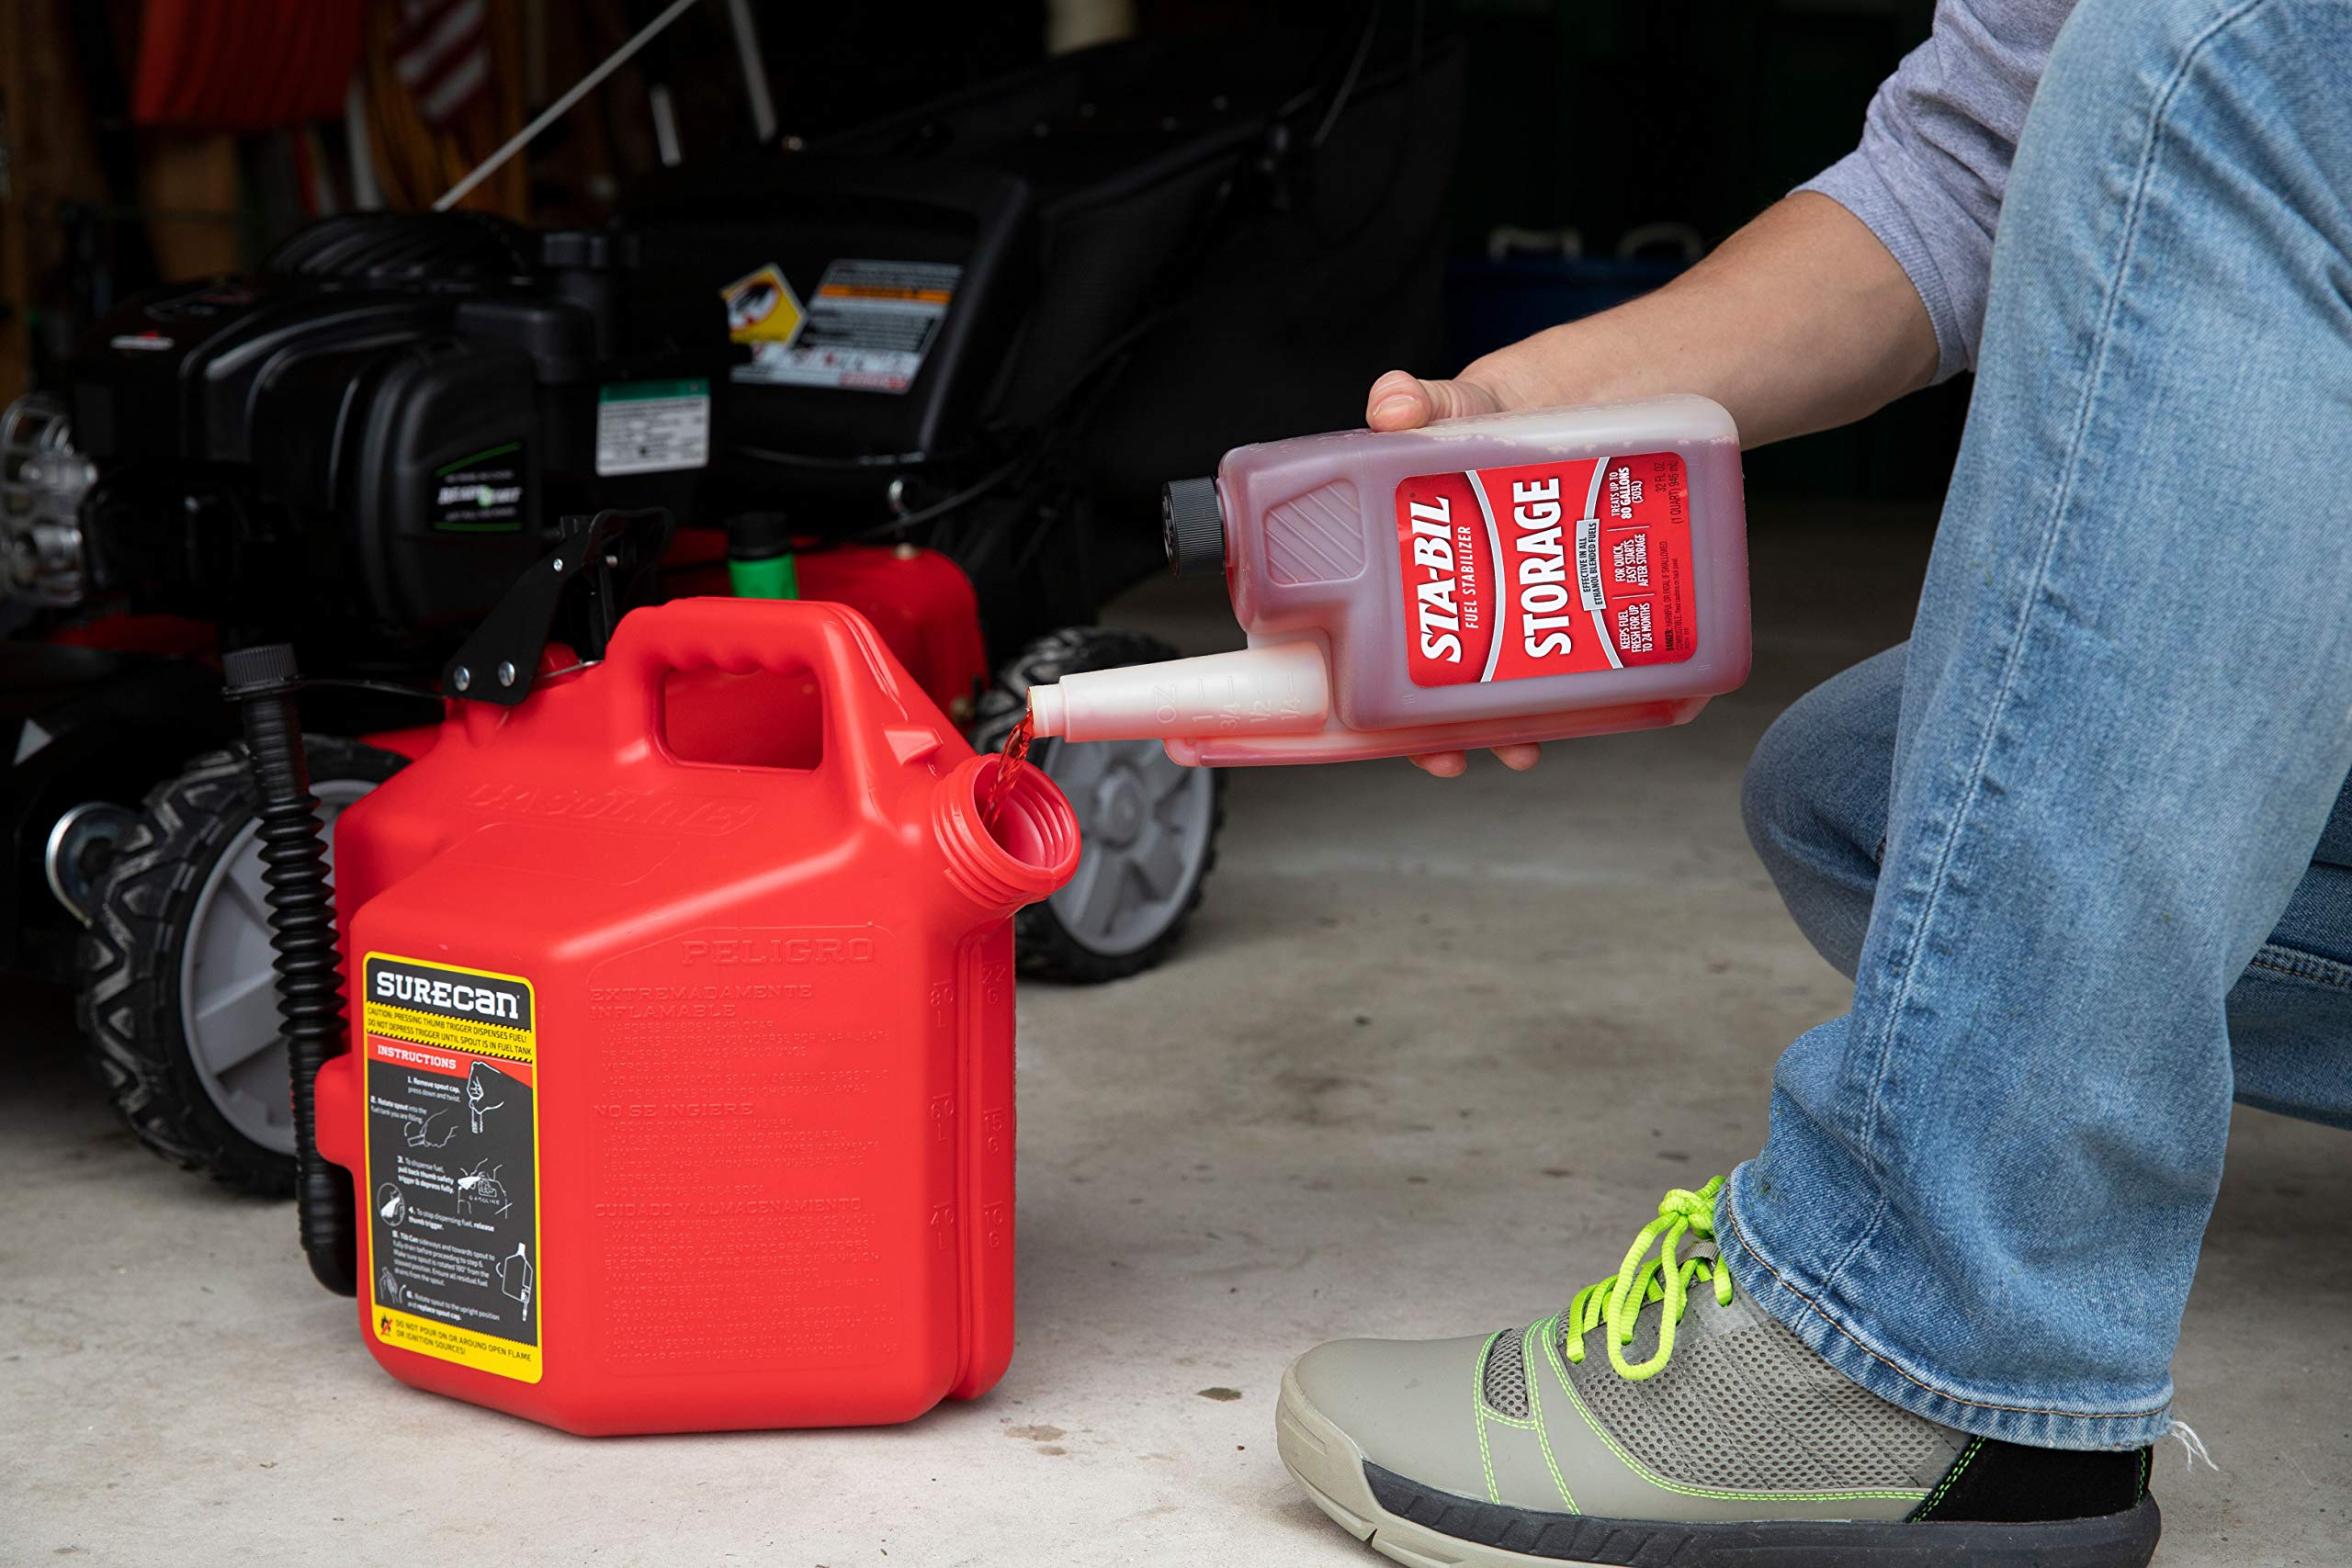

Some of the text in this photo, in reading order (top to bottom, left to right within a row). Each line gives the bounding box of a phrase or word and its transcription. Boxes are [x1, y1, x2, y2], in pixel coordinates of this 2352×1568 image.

[1609, 471, 1621, 516] TREATS UP TO
[1618, 467, 1633, 520] 80 GALLONS
[1631, 480, 1644, 503] (303L)
[1654, 461, 1667, 492] 32 FL OZ
[1668, 473, 1679, 487] 946
[1578, 536, 1587, 549] ALL
[1634, 533, 1649, 587] AFTER STORAGE
[1457, 525, 1479, 629] FUEL STABILIZER
[1512, 478, 1572, 659] STORAGE
[1579, 558, 1591, 592] EFFECTIVE
[1588, 523, 1603, 605] ETHANOL BLENDED FUELS
[1612, 542, 1625, 582] FOR QUICK,
[1623, 539, 1637, 583] EASY STARTS
[1409, 496, 1462, 664] STA-BIL
[1617, 609, 1631, 649] KEEPS FUEL
[1628, 604, 1642, 653] FRESH FOR UP
[1639, 603, 1653, 653] TO 24 MONTHS
[680, 938, 876, 966] PELIGRO
[589, 985, 815, 1002] EXTREMADAMENTE
[368, 1007, 527, 1043] CAUTION: PRESSING THUMB TRIGGER DISPENSES FUEL!
[589, 1004, 737, 1020] INFLAMABLE
[368, 1019, 532, 1055] DO NOT DEPRESS TRIGGER UNTIL SPOUT IS IN FUEL TANK
[378, 1044, 458, 1070] INSTRUCTIONS
[593, 1102, 754, 1118] NO SE INGIERE
[595, 1197, 863, 1217] CUIDADO Y ALMACENAMIENTO
[396, 1319, 532, 1362] DO NOT POUR ON OR AROUND OPEN FLAME
[396, 1329, 467, 1355] OR IGNITION SOURCES!
